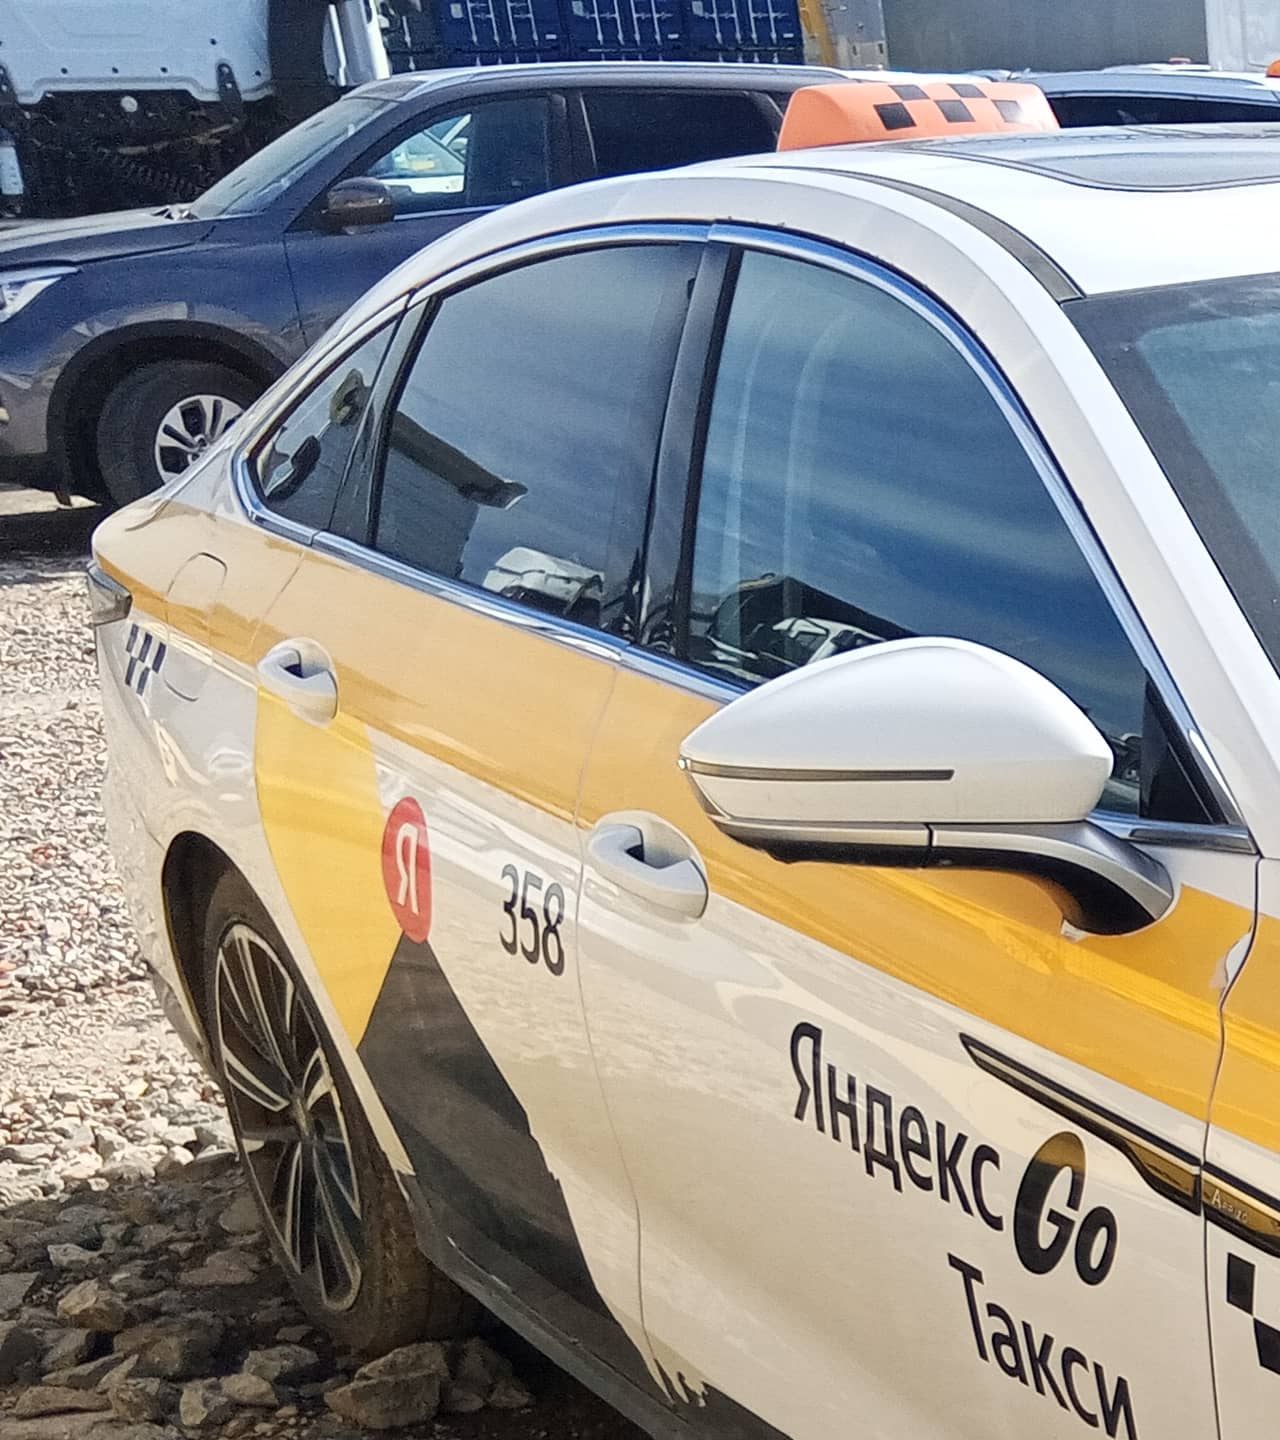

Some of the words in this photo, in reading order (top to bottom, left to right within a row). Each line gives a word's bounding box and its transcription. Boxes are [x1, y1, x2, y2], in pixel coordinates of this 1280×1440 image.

[395, 821, 420, 917] Я
[499, 863, 566, 976] 358
[789, 1021, 1005, 1233] Яндекс
[1012, 1130, 1119, 1287] Go
